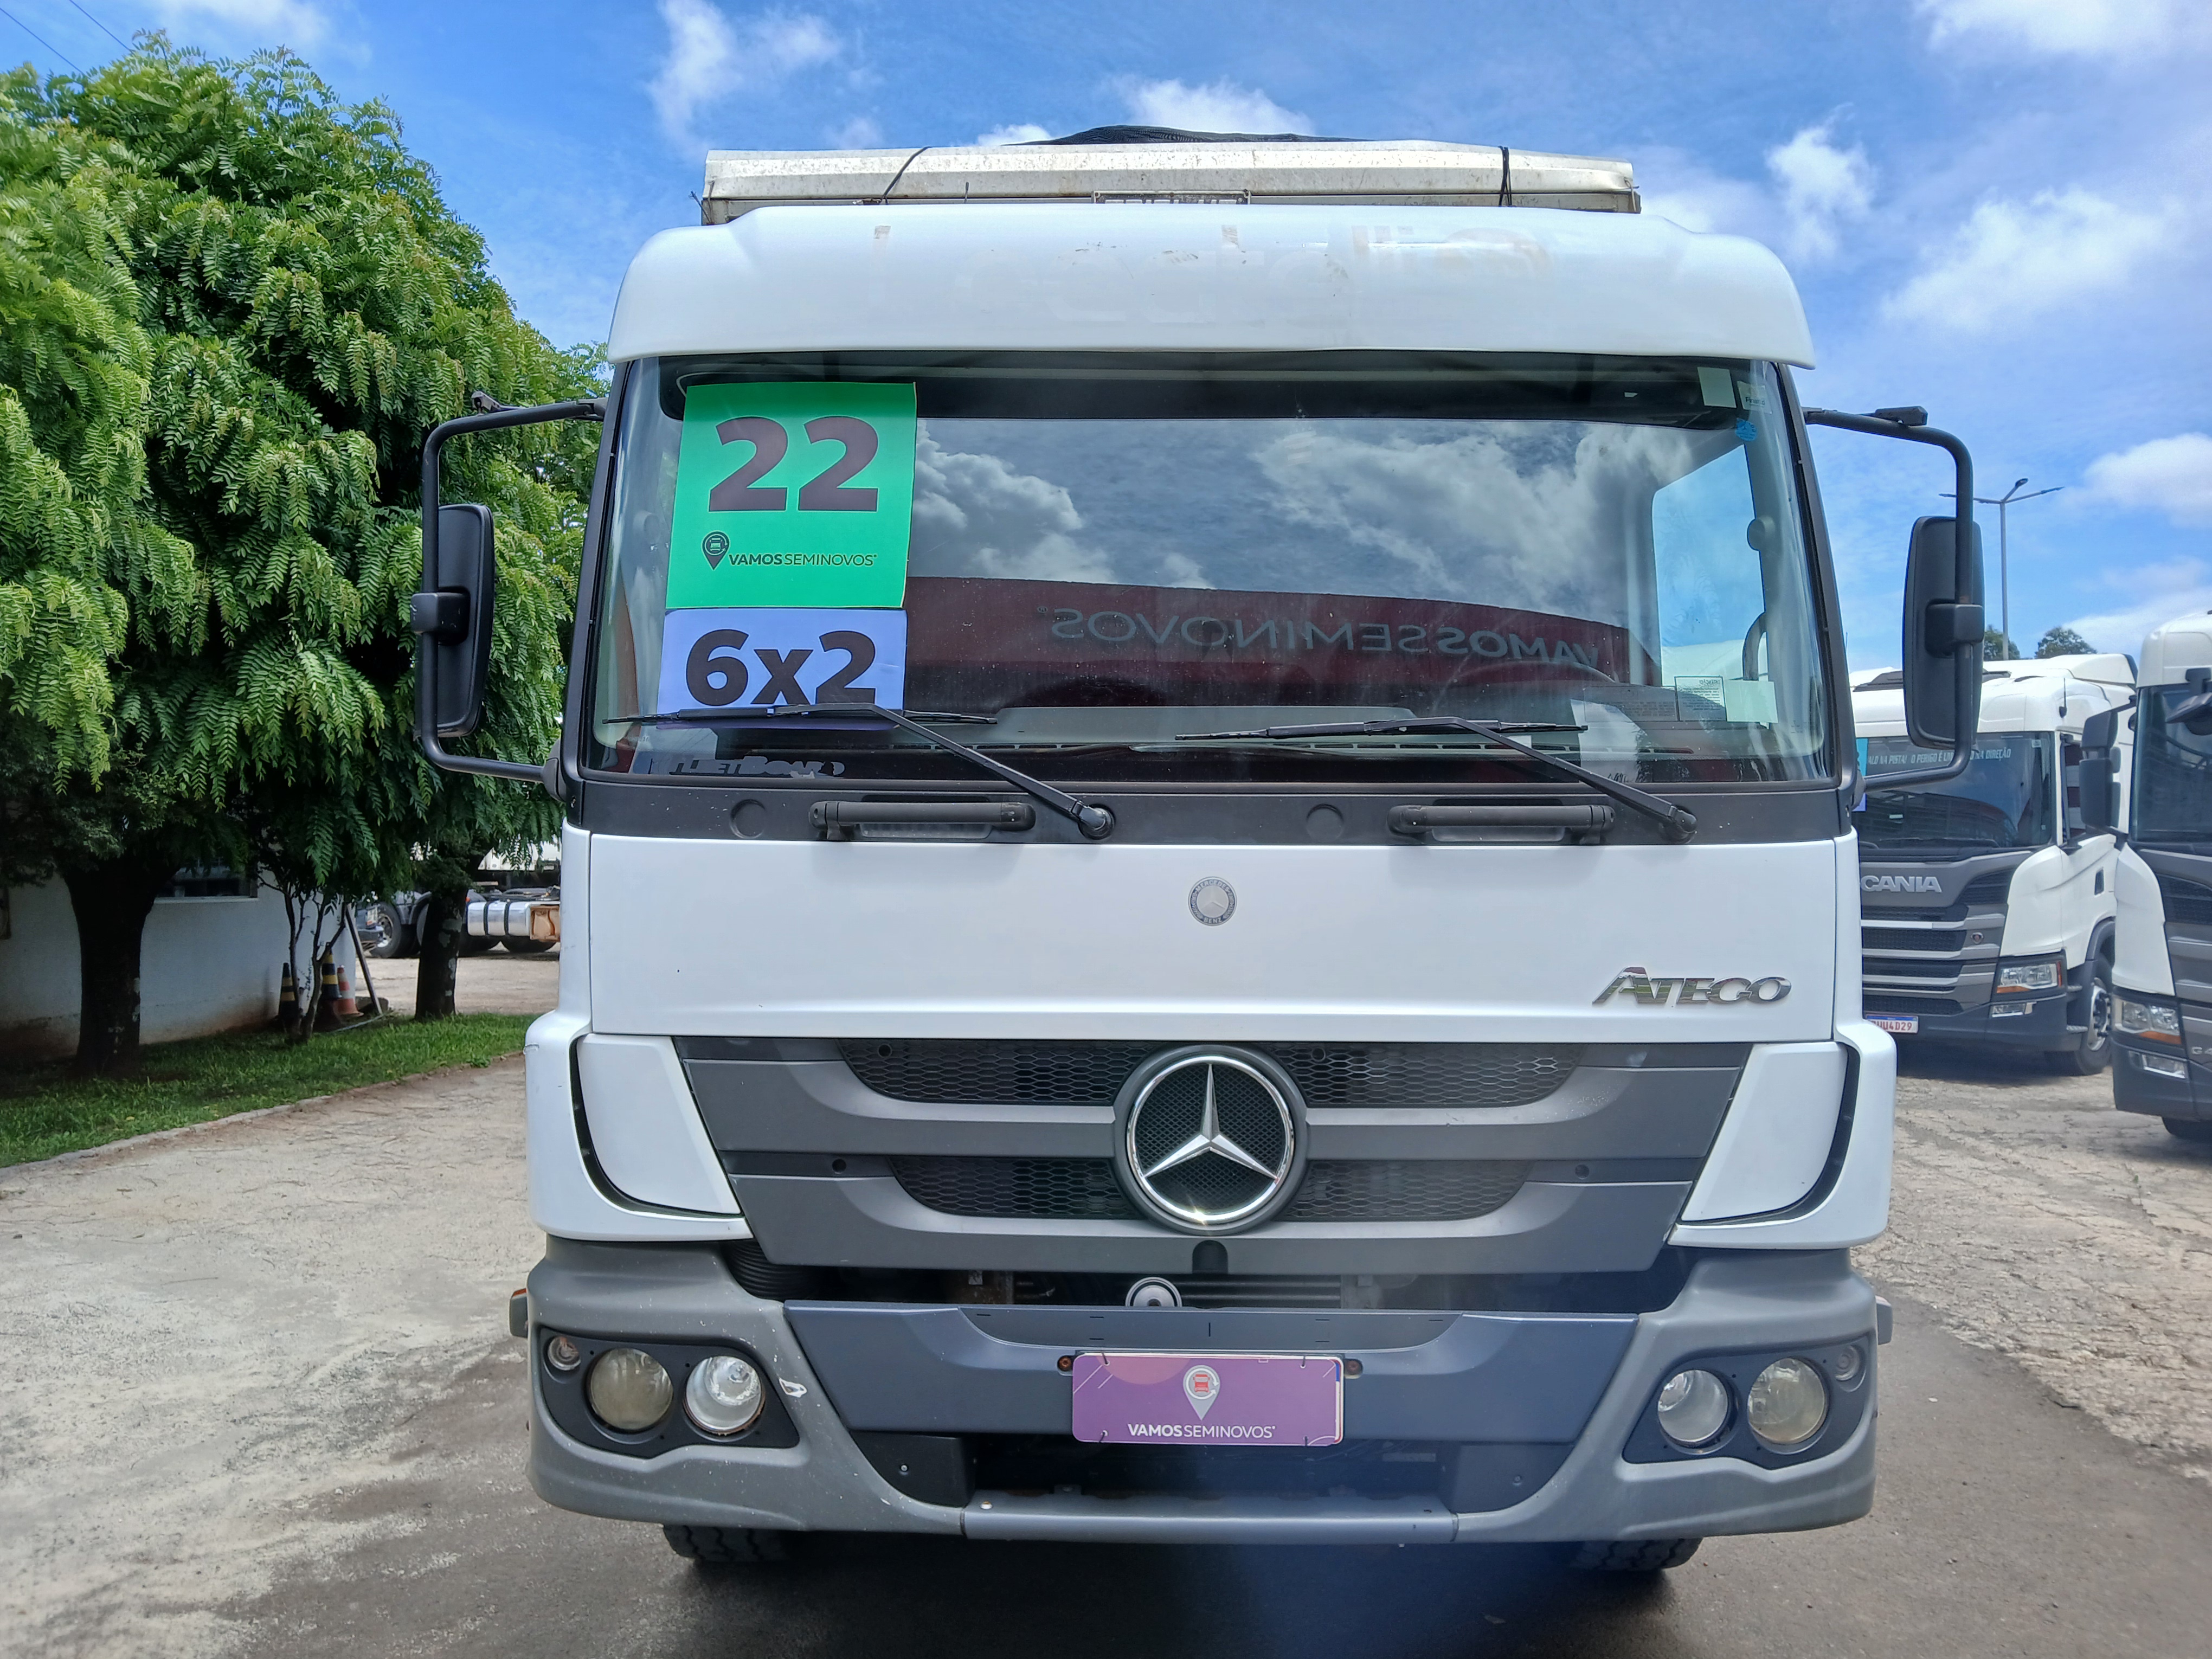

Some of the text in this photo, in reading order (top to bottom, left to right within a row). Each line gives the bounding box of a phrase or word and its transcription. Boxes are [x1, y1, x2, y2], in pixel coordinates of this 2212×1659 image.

[708, 415, 878, 512] 22
[685, 628, 876, 706] 6x2
[1195, 879, 1231, 893] MERCEDES
[1860, 875, 1943, 893] CANIA
[1592, 966, 1792, 1005] ATEGO
